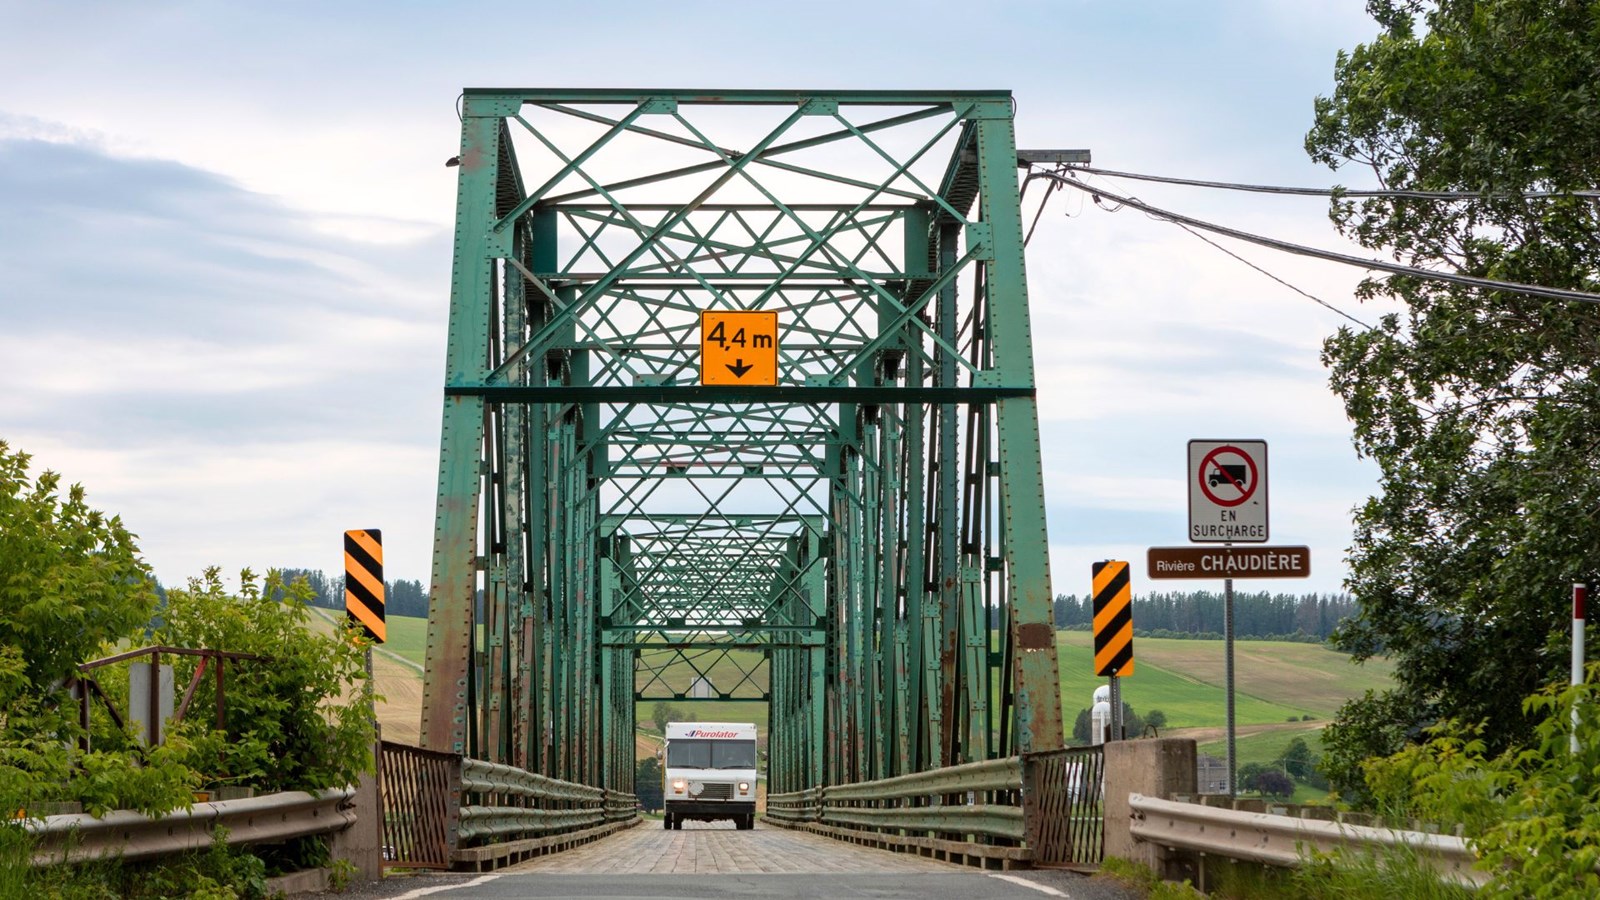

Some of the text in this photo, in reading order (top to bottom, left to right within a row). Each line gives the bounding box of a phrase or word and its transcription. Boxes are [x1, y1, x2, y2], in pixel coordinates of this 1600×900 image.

[707, 321, 772, 351] 4,4 m
[1221, 510, 1236, 522] EN
[1194, 525, 1264, 537] SURCHARGE
[1157, 552, 1301, 571] Rivière CHAUDIÈRE
[695, 730, 738, 738] Purolator
